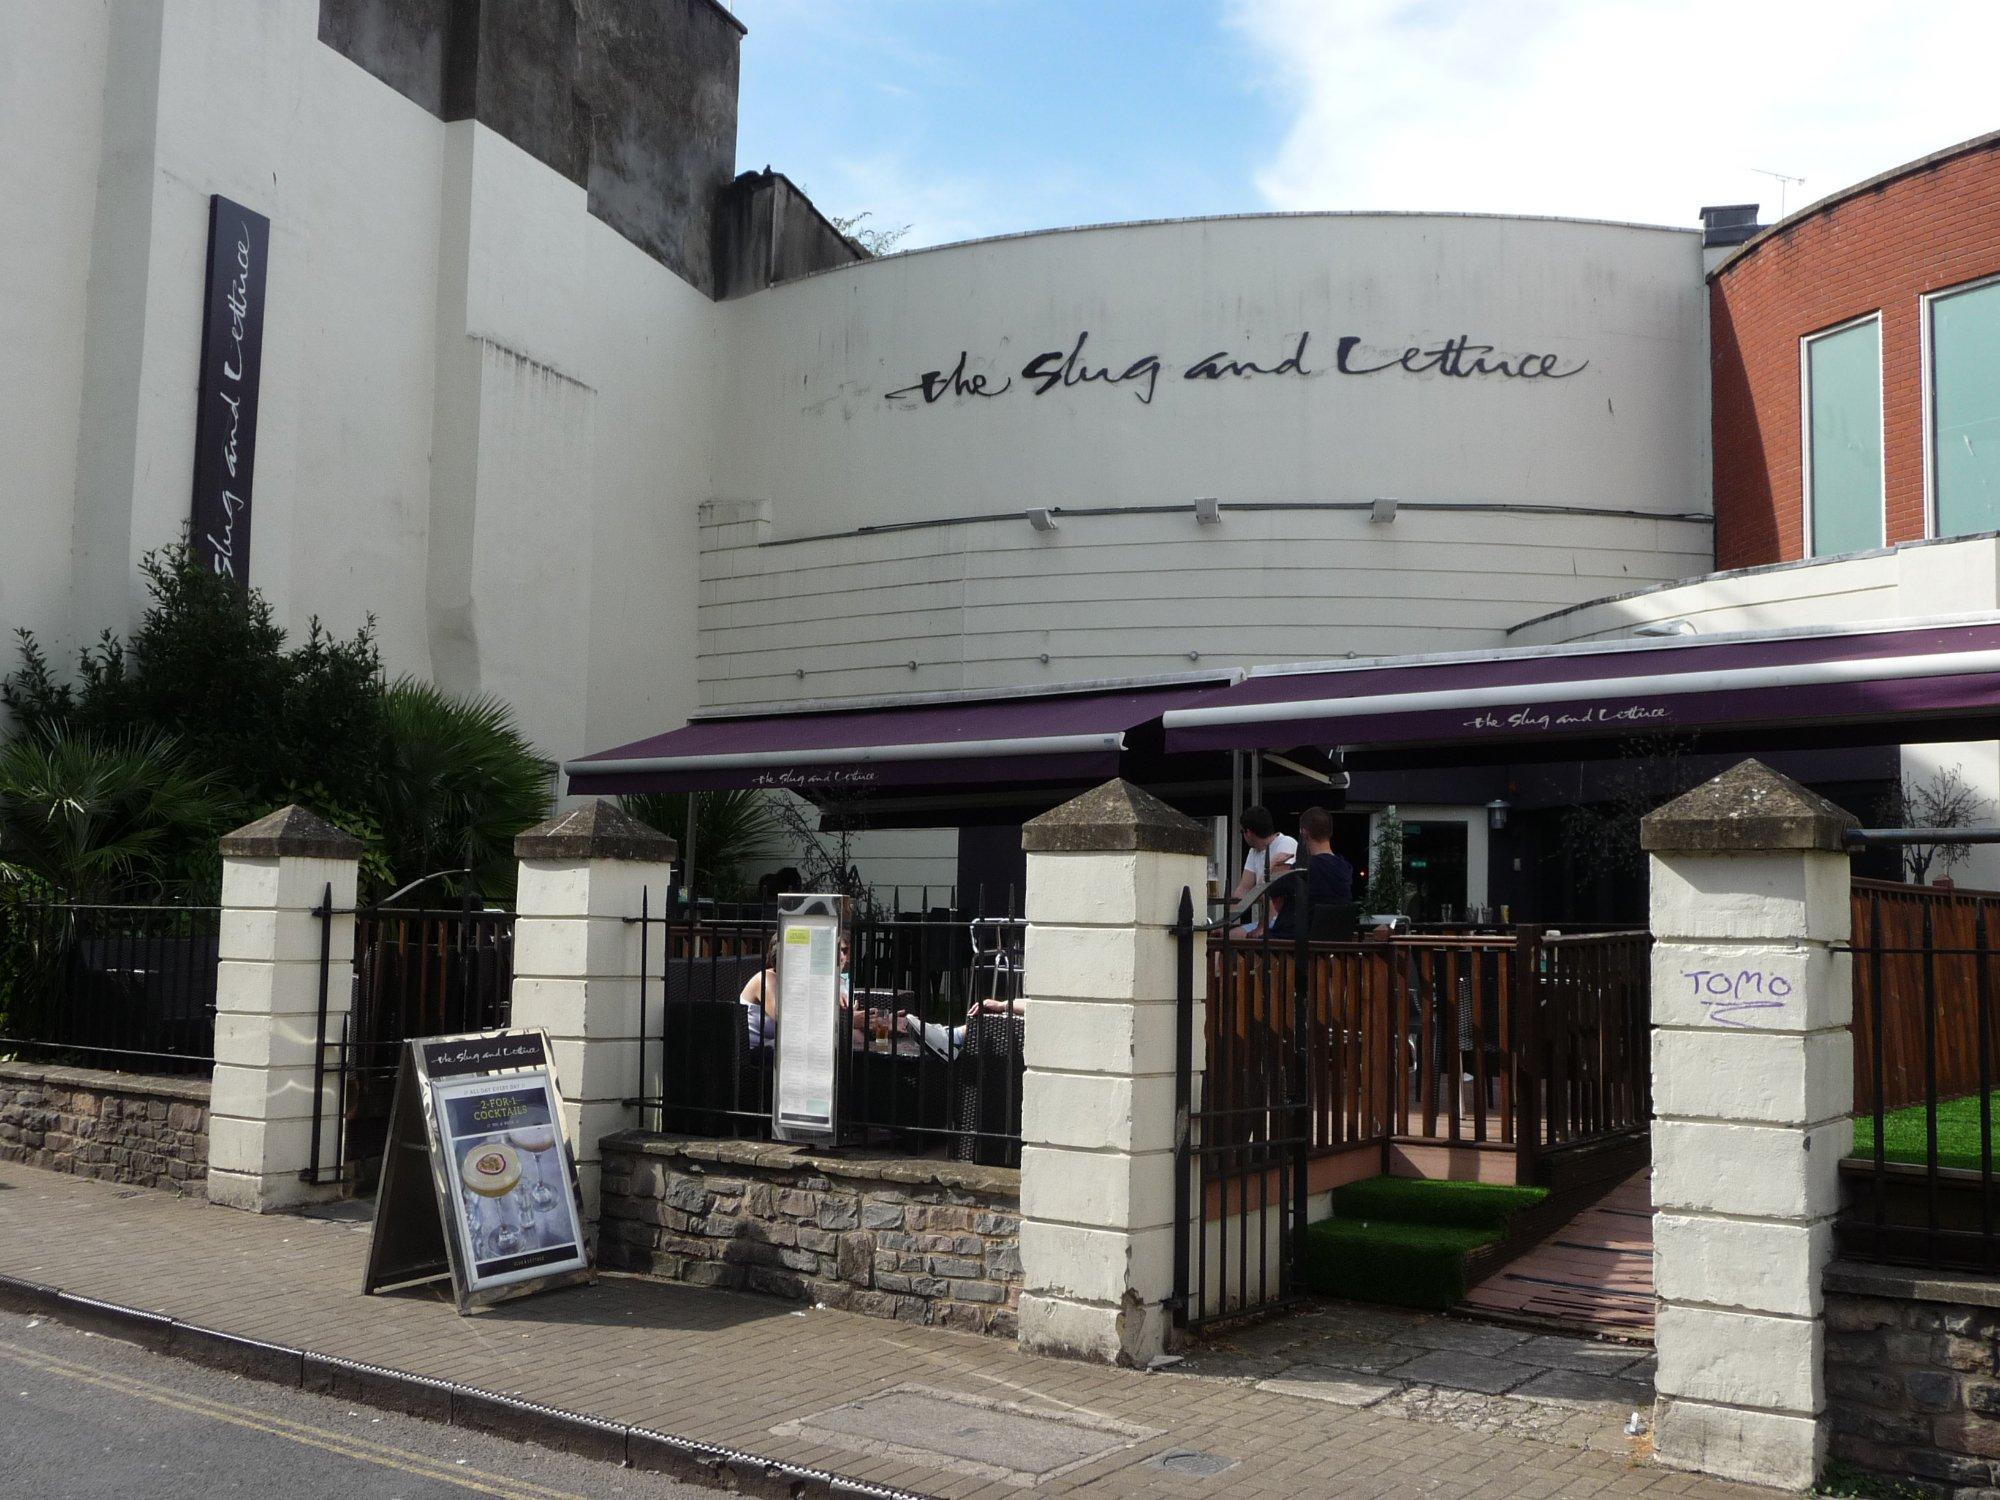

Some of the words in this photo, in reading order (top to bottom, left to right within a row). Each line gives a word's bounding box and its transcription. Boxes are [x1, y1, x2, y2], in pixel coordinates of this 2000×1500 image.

[224, 220, 251, 381] Lettuce
[884, 350, 1012, 403] the
[1021, 331, 1161, 404] Slug
[1183, 331, 1312, 380] and
[1336, 334, 1590, 379] Lettuce
[219, 390, 241, 478] and
[206, 490, 245, 578] Slug
[1463, 712, 1504, 729] the
[1507, 707, 1550, 730] Slug
[1555, 708, 1593, 725] and
[1599, 706, 1673, 722] Lettuce
[752, 771, 776, 784] the
[779, 768, 805, 787] Slug
[807, 770, 832, 783] and
[1683, 970, 1792, 999] TOMO
[431, 1053, 456, 1064] the
[456, 1049, 480, 1063] Slug
[482, 1048, 501, 1059] and
[469, 1087, 479, 1095] ALL
[480, 1097, 517, 1109] 2-FOR-1
[473, 1105, 528, 1121] COCKTAILS
